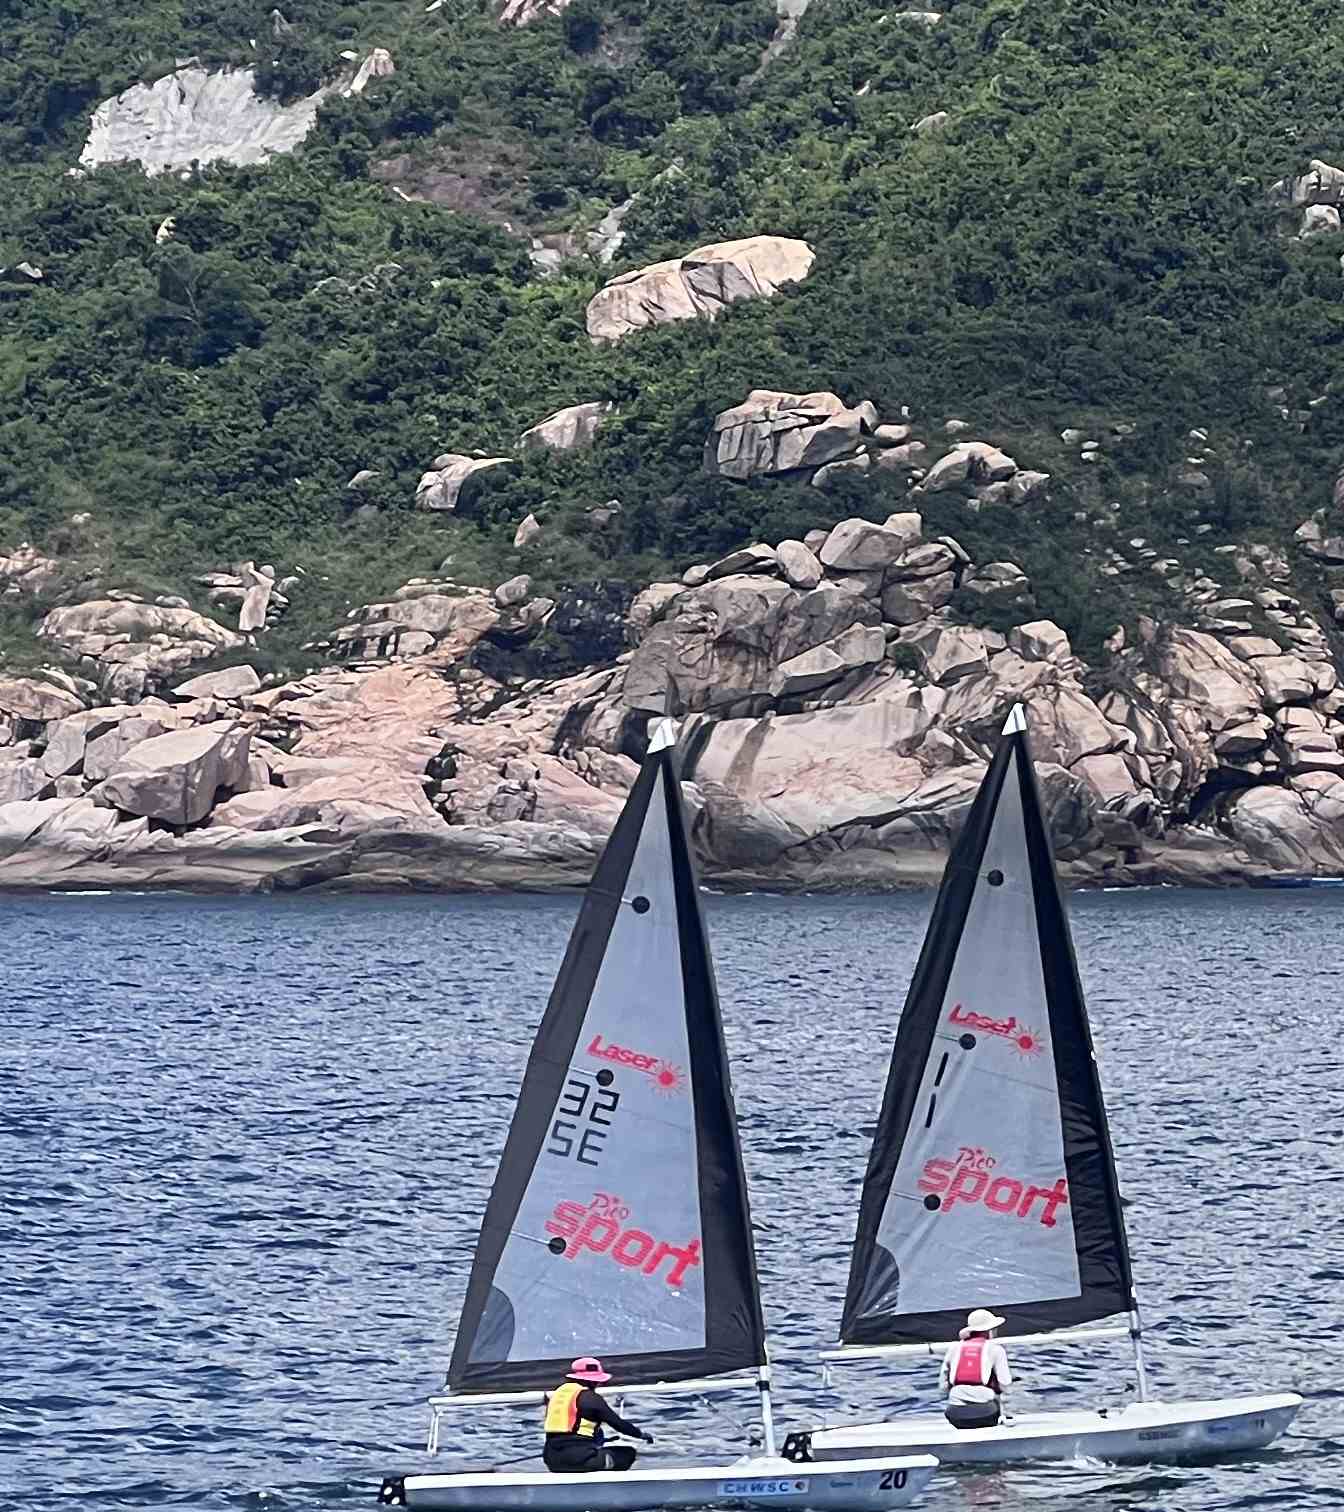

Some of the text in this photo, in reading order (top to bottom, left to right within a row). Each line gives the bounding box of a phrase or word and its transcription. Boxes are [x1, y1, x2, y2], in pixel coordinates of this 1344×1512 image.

[585, 1034, 659, 1070] Laser
[559, 1079, 621, 1126] 32
[917, 1157, 1069, 1229] sport
[544, 1200, 701, 1288] sport
[879, 1470, 908, 1490] 20
